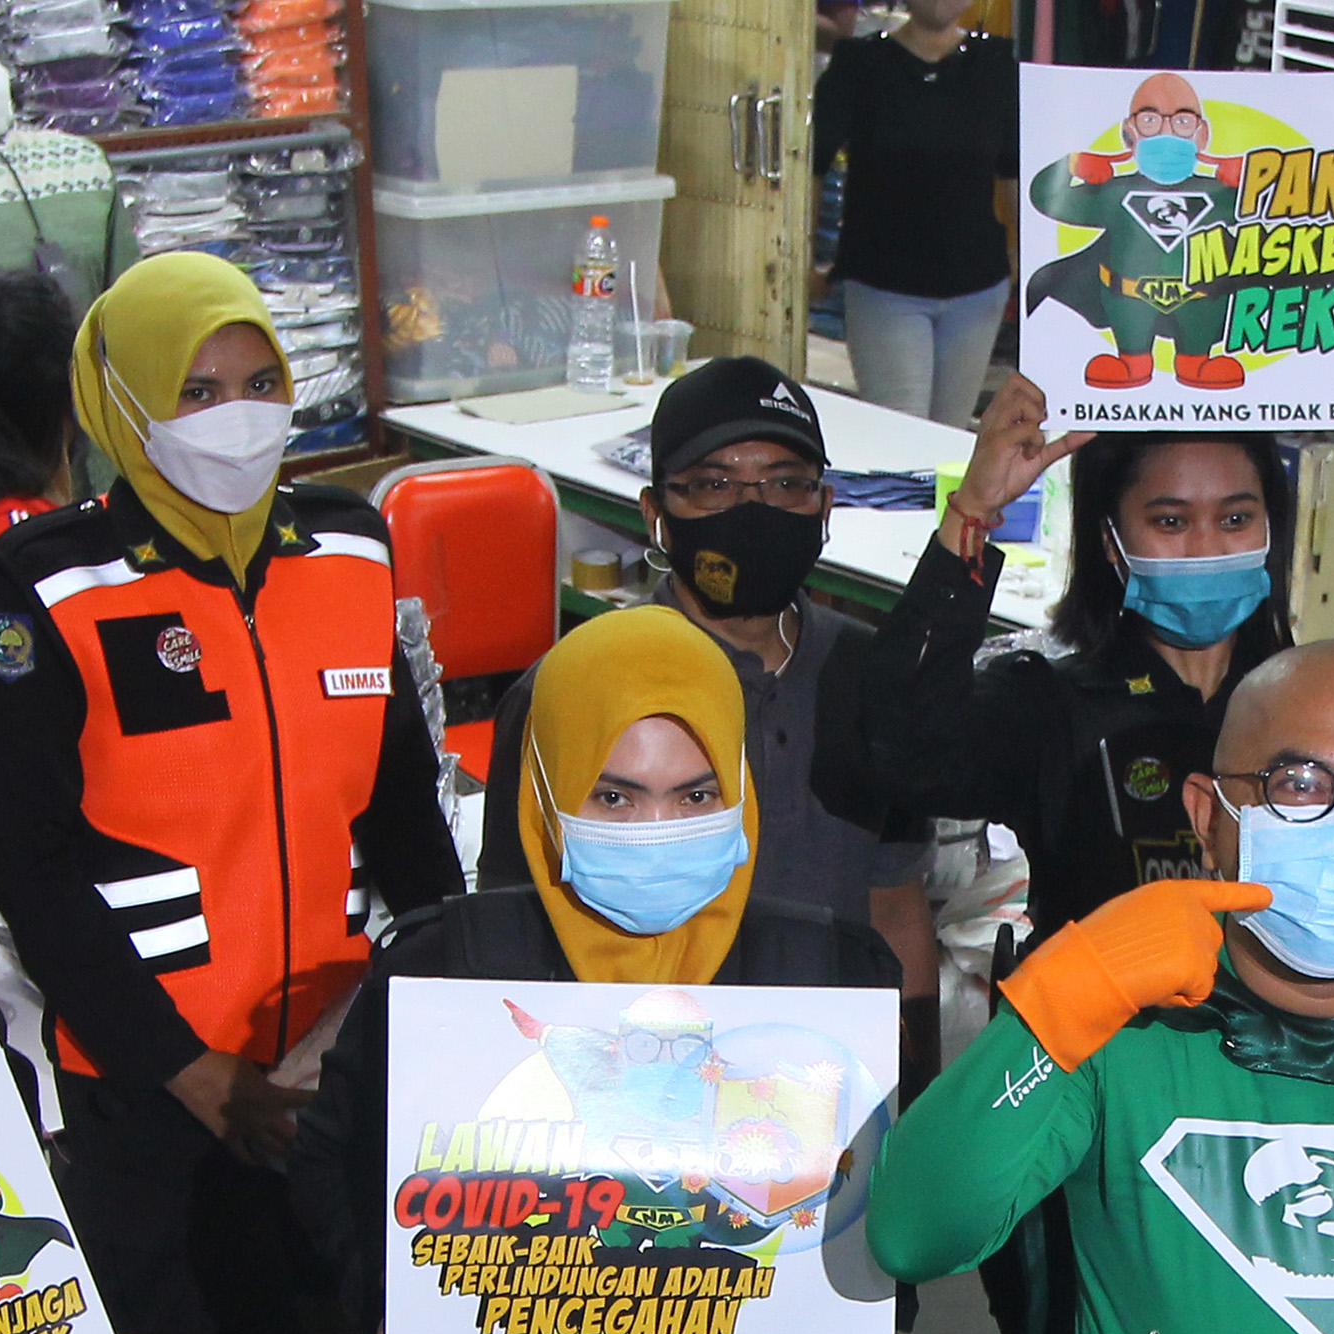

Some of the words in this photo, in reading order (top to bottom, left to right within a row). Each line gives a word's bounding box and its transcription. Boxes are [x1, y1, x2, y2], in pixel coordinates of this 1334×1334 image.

[1074, 404, 1184, 422] BIASAKAN
[1192, 404, 1250, 422] YANG
[1260, 404, 1321, 421] TIDAK
[163, 634, 192, 652] CARE
[173, 648, 201, 669] SMILE
[331, 672, 385, 690] LINMAS
[417, 1121, 586, 1174] LAWAN
[394, 1174, 626, 1231] COVID-19
[413, 1233, 597, 1266] SEBAIK-BAIK
[441, 1264, 657, 1299] PERLINDUNGAN
[663, 1266, 774, 1299] ADALAH
